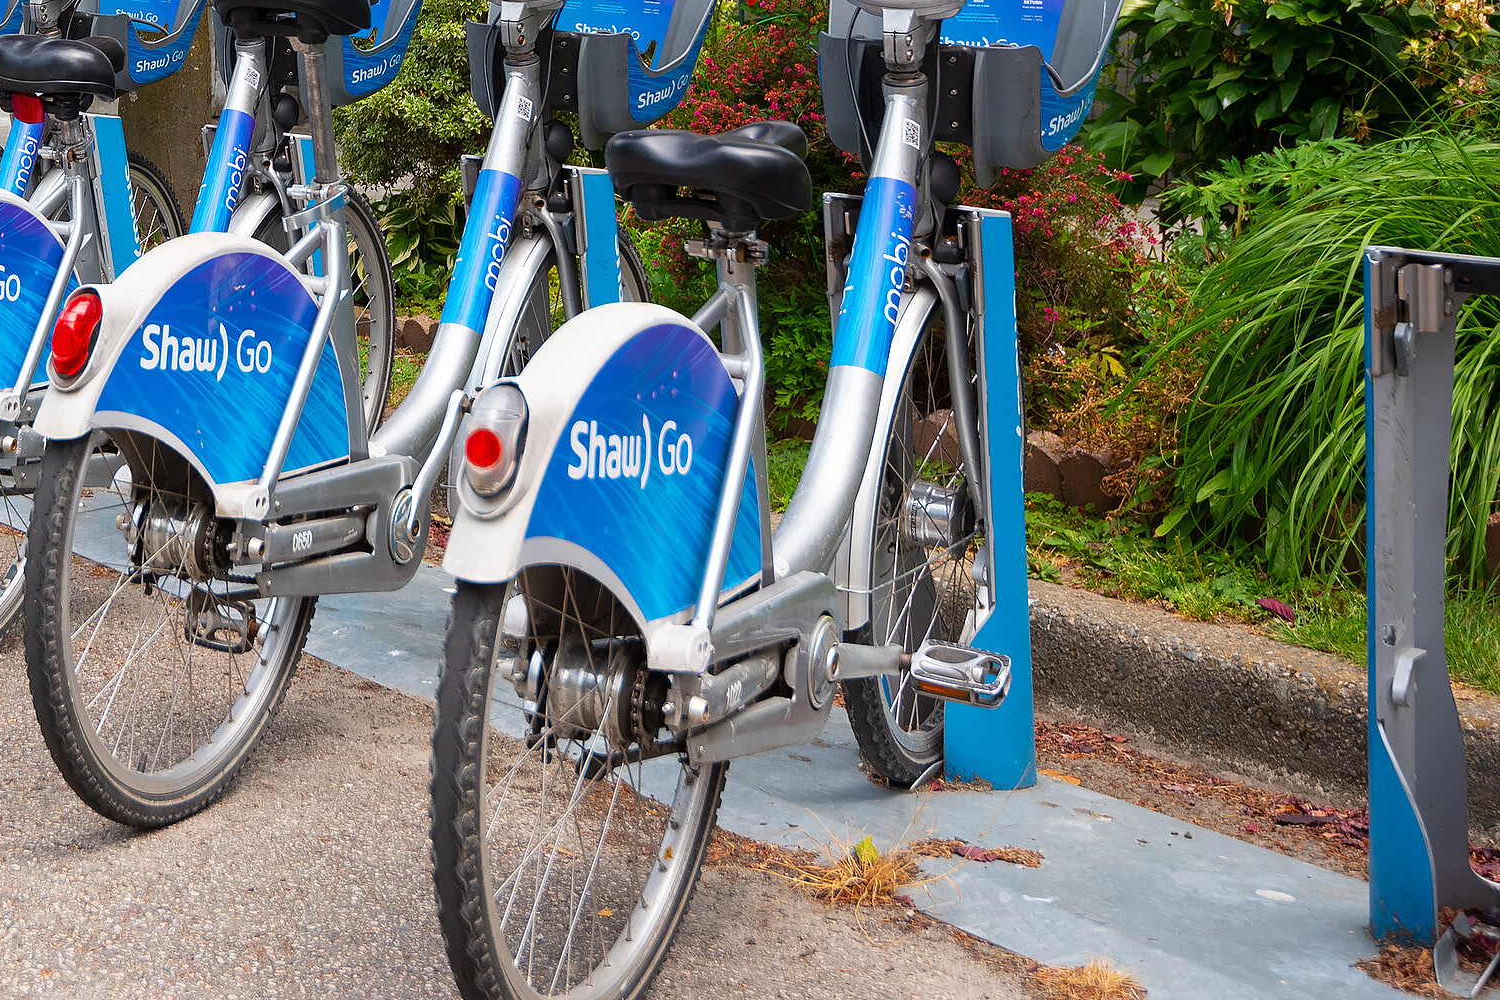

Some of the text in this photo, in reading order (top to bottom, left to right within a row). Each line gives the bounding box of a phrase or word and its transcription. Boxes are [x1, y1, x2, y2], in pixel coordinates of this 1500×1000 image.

[145, 13, 158, 23] Go
[171, 50, 184, 63] Go
[389, 54, 401, 68] Go
[676, 74, 689, 90] Go
[15, 134, 39, 192] mobi
[225, 146, 248, 213] mobi
[484, 214, 512, 292] mobi
[883, 231, 911, 326] mobi
[236, 329, 273, 374] Go
[658, 420, 692, 475] Go
